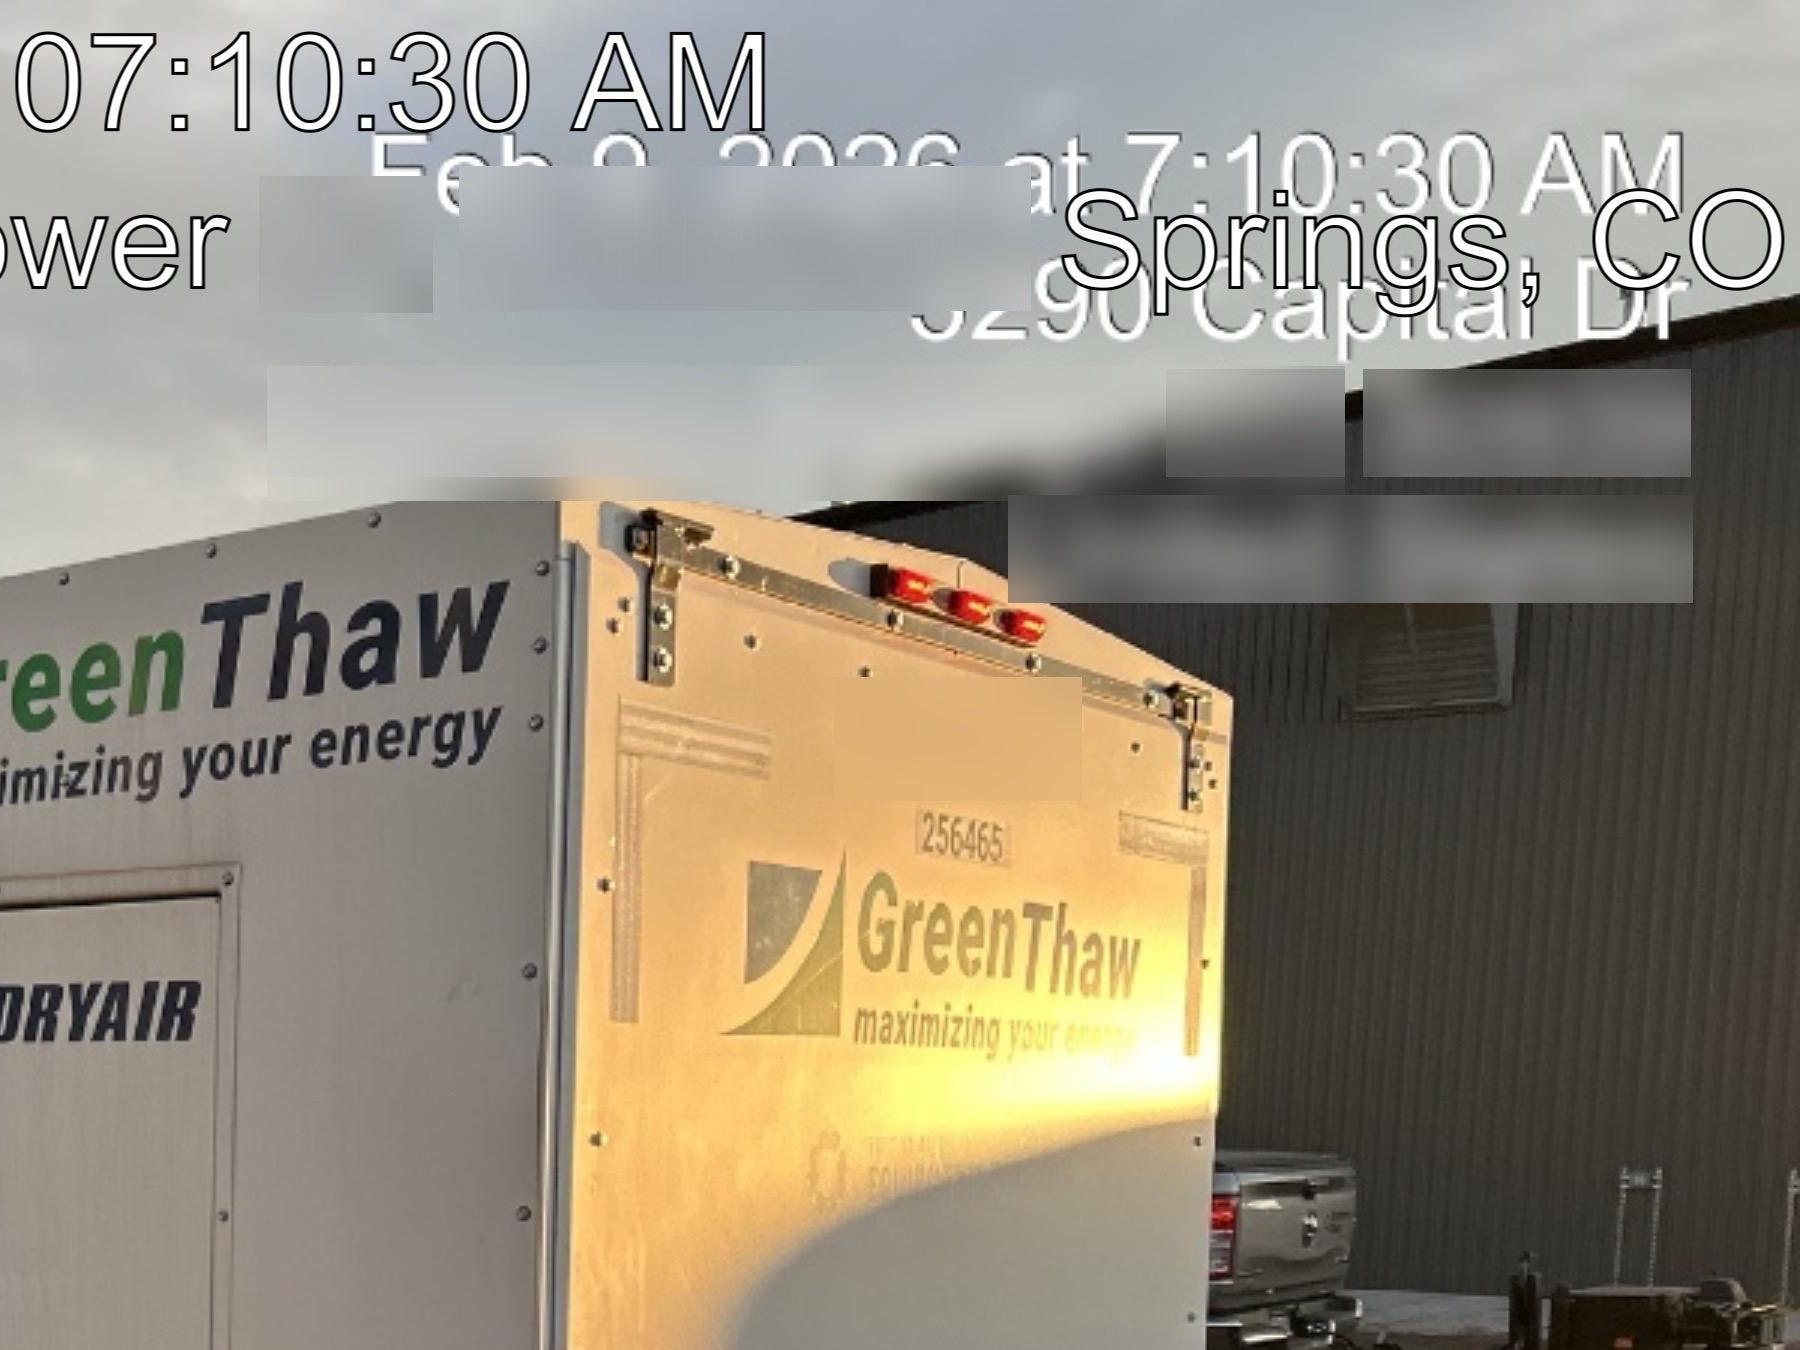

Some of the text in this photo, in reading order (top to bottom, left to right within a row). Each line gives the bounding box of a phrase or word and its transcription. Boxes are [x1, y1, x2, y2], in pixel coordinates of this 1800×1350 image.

[178, 733, 292, 799] your
[311, 705, 504, 769] energy
[920, 811, 1004, 864] 256465
[853, 999, 1001, 1062] maximizing
[1009, 1019, 1060, 1062] your
